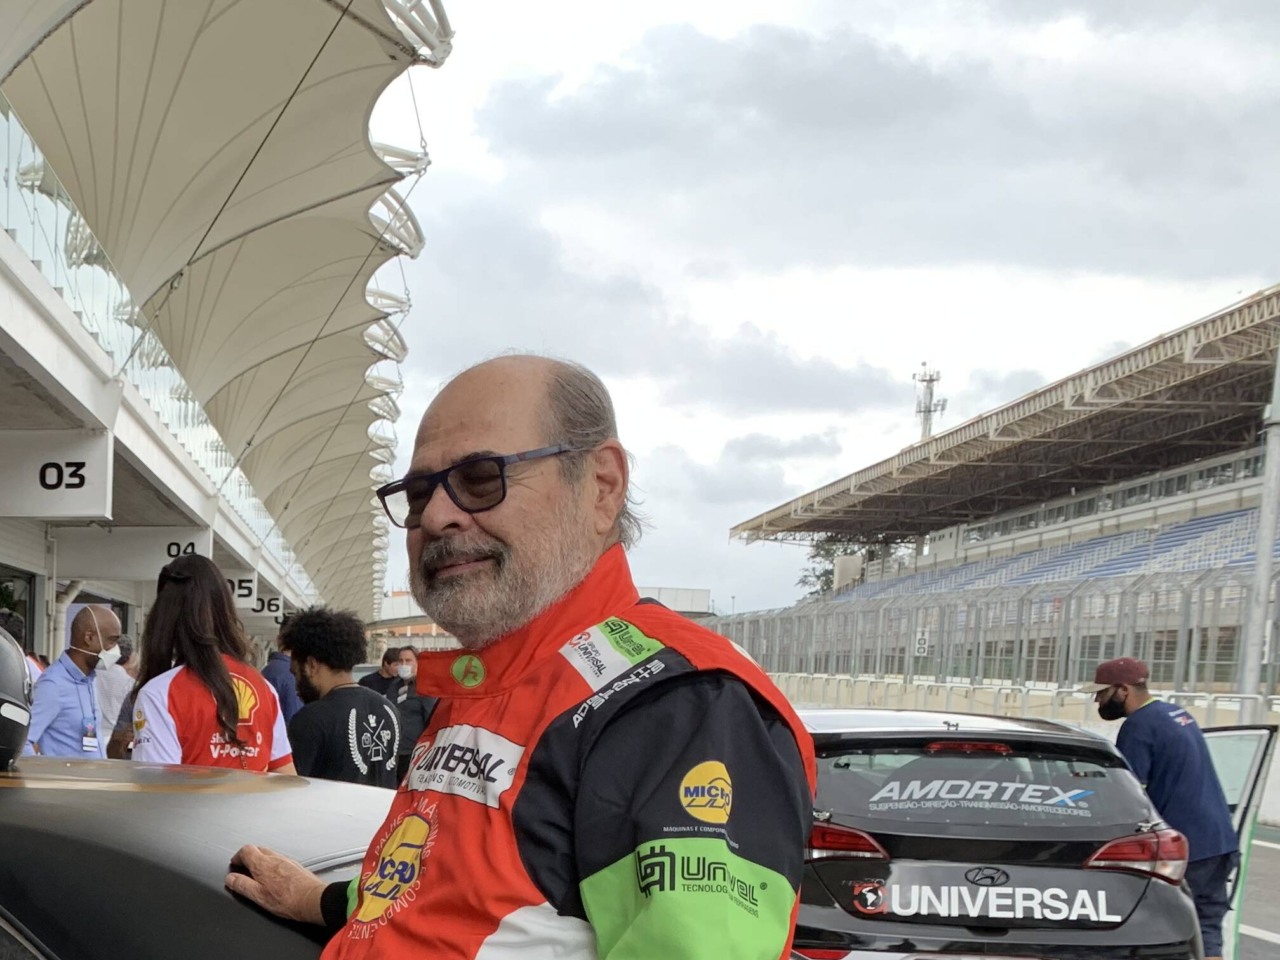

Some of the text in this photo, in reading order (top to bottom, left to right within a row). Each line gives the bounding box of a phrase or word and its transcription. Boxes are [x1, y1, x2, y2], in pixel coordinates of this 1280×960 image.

[39, 462, 86, 490] 03
[870, 780, 1096, 808] AMORTEX
[891, 884, 1122, 923] UNIVERSAL
